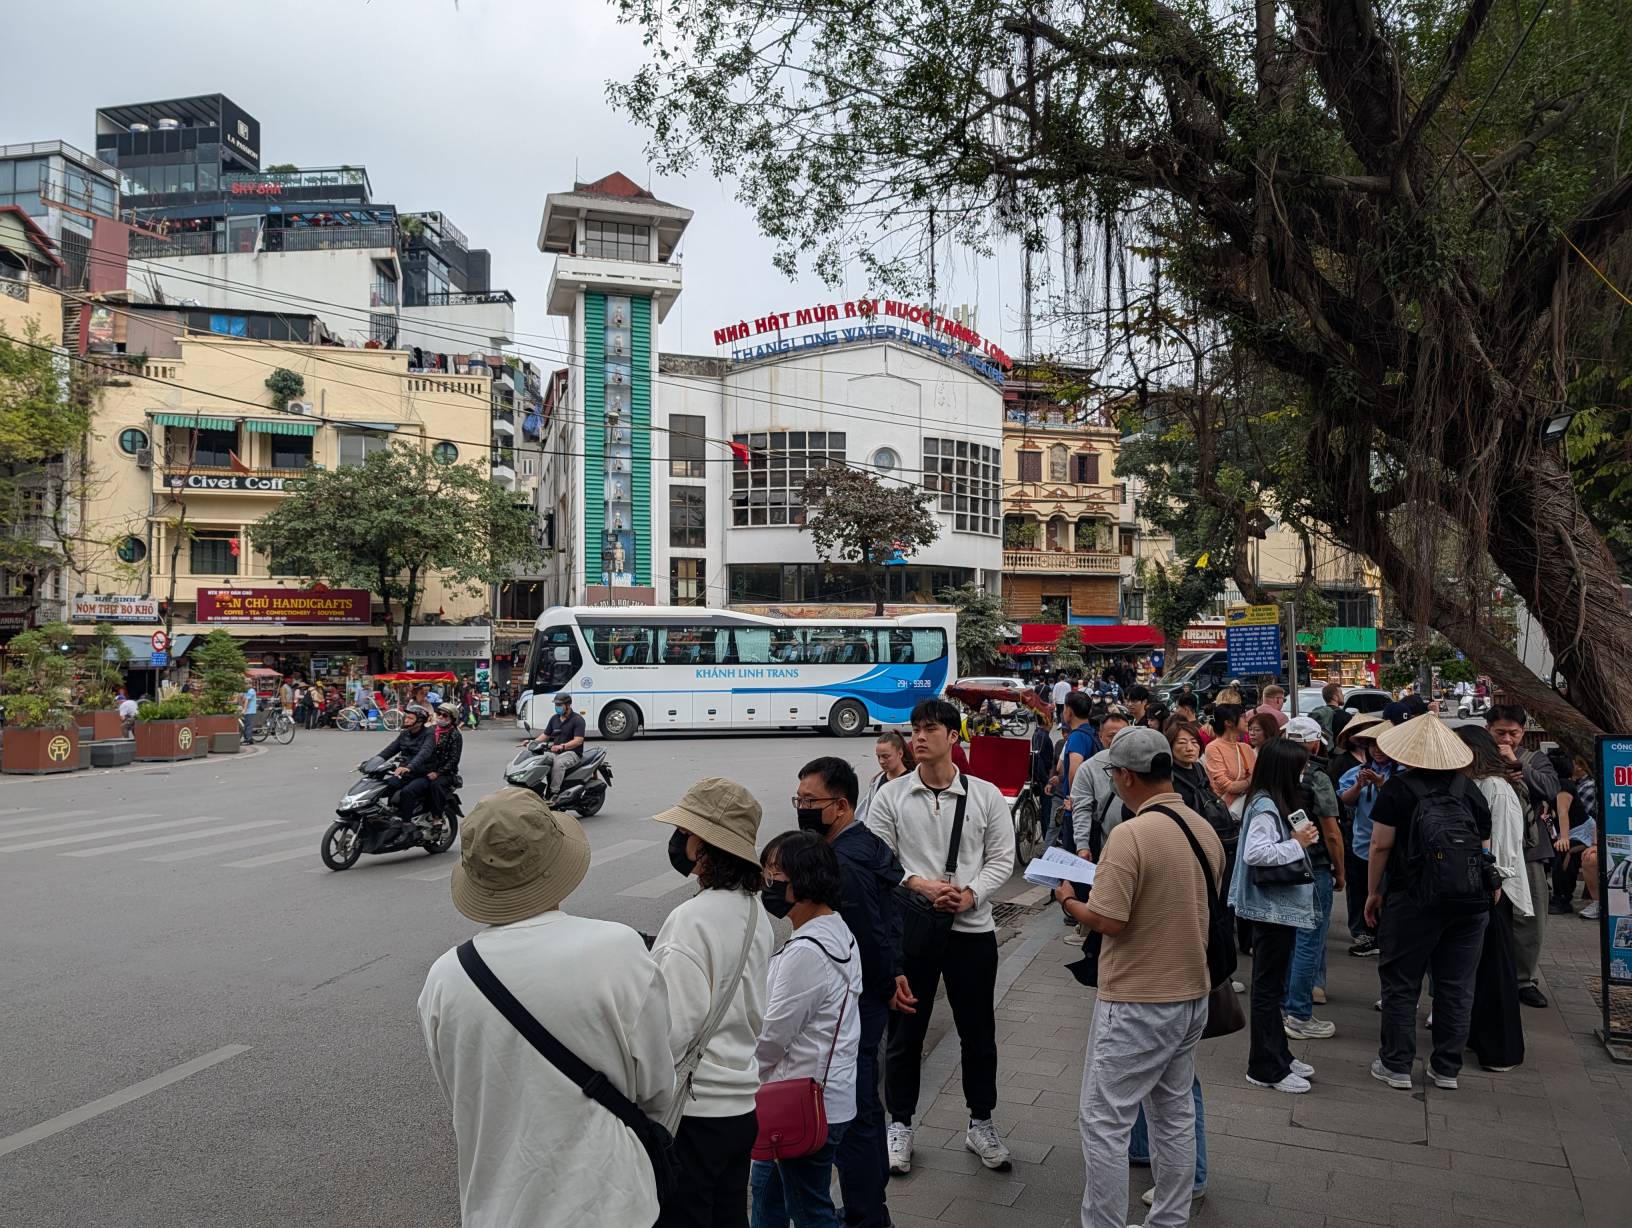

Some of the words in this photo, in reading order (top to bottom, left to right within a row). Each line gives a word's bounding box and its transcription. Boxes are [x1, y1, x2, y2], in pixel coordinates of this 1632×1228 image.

[713, 319, 750, 346] NHÀ
[754, 311, 790, 334] HÁT
[796, 302, 838, 326] MÚA
[983, 338, 1014, 370] LONG
[732, 338, 790, 363] THANG
[792, 330, 838, 352] LONG
[841, 324, 897, 343] WATER
[899, 327, 958, 359] PUPPET
[188, 475, 238, 489] Civet
[245, 595, 269, 608] CHỦ
[272, 598, 353, 609] HANDICRAFTS
[695, 667, 737, 678] KHÁNH
[738, 668, 765, 678] LINH
[767, 668, 799, 678] TRANS
[1610, 793, 1626, 807] XE
